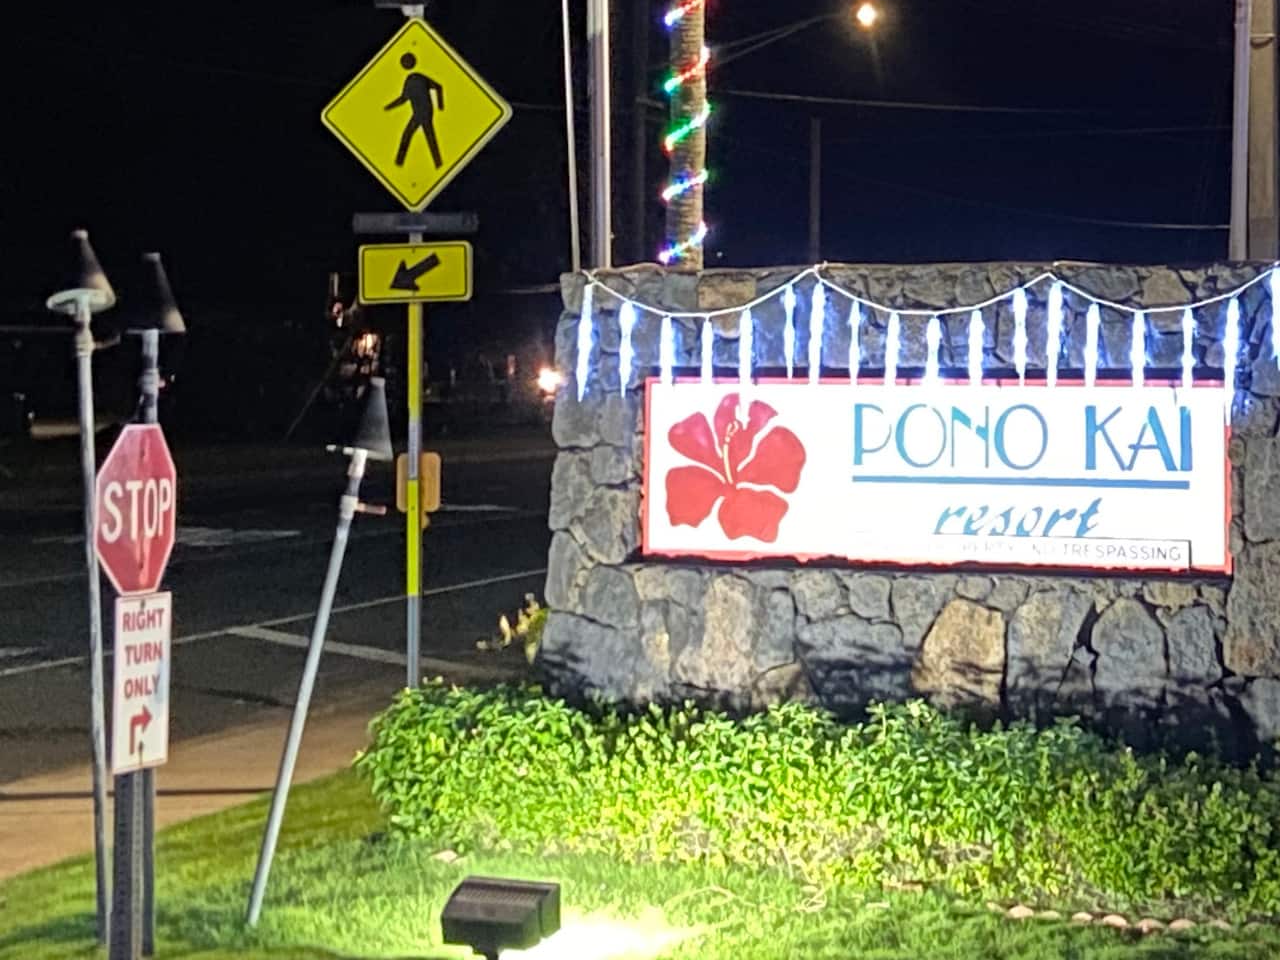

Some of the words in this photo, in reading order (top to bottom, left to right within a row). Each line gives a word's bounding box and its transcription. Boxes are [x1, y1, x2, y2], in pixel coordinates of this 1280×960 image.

[853, 403, 1049, 470] PONO
[1085, 405, 1193, 472] KAI
[101, 477, 172, 544] STOP
[932, 497, 1103, 538] resort
[1063, 543, 1182, 561] TRESPASSING
[122, 607, 165, 631] RIGHT
[124, 643, 163, 667] TURN
[123, 674, 161, 700] ONLY
